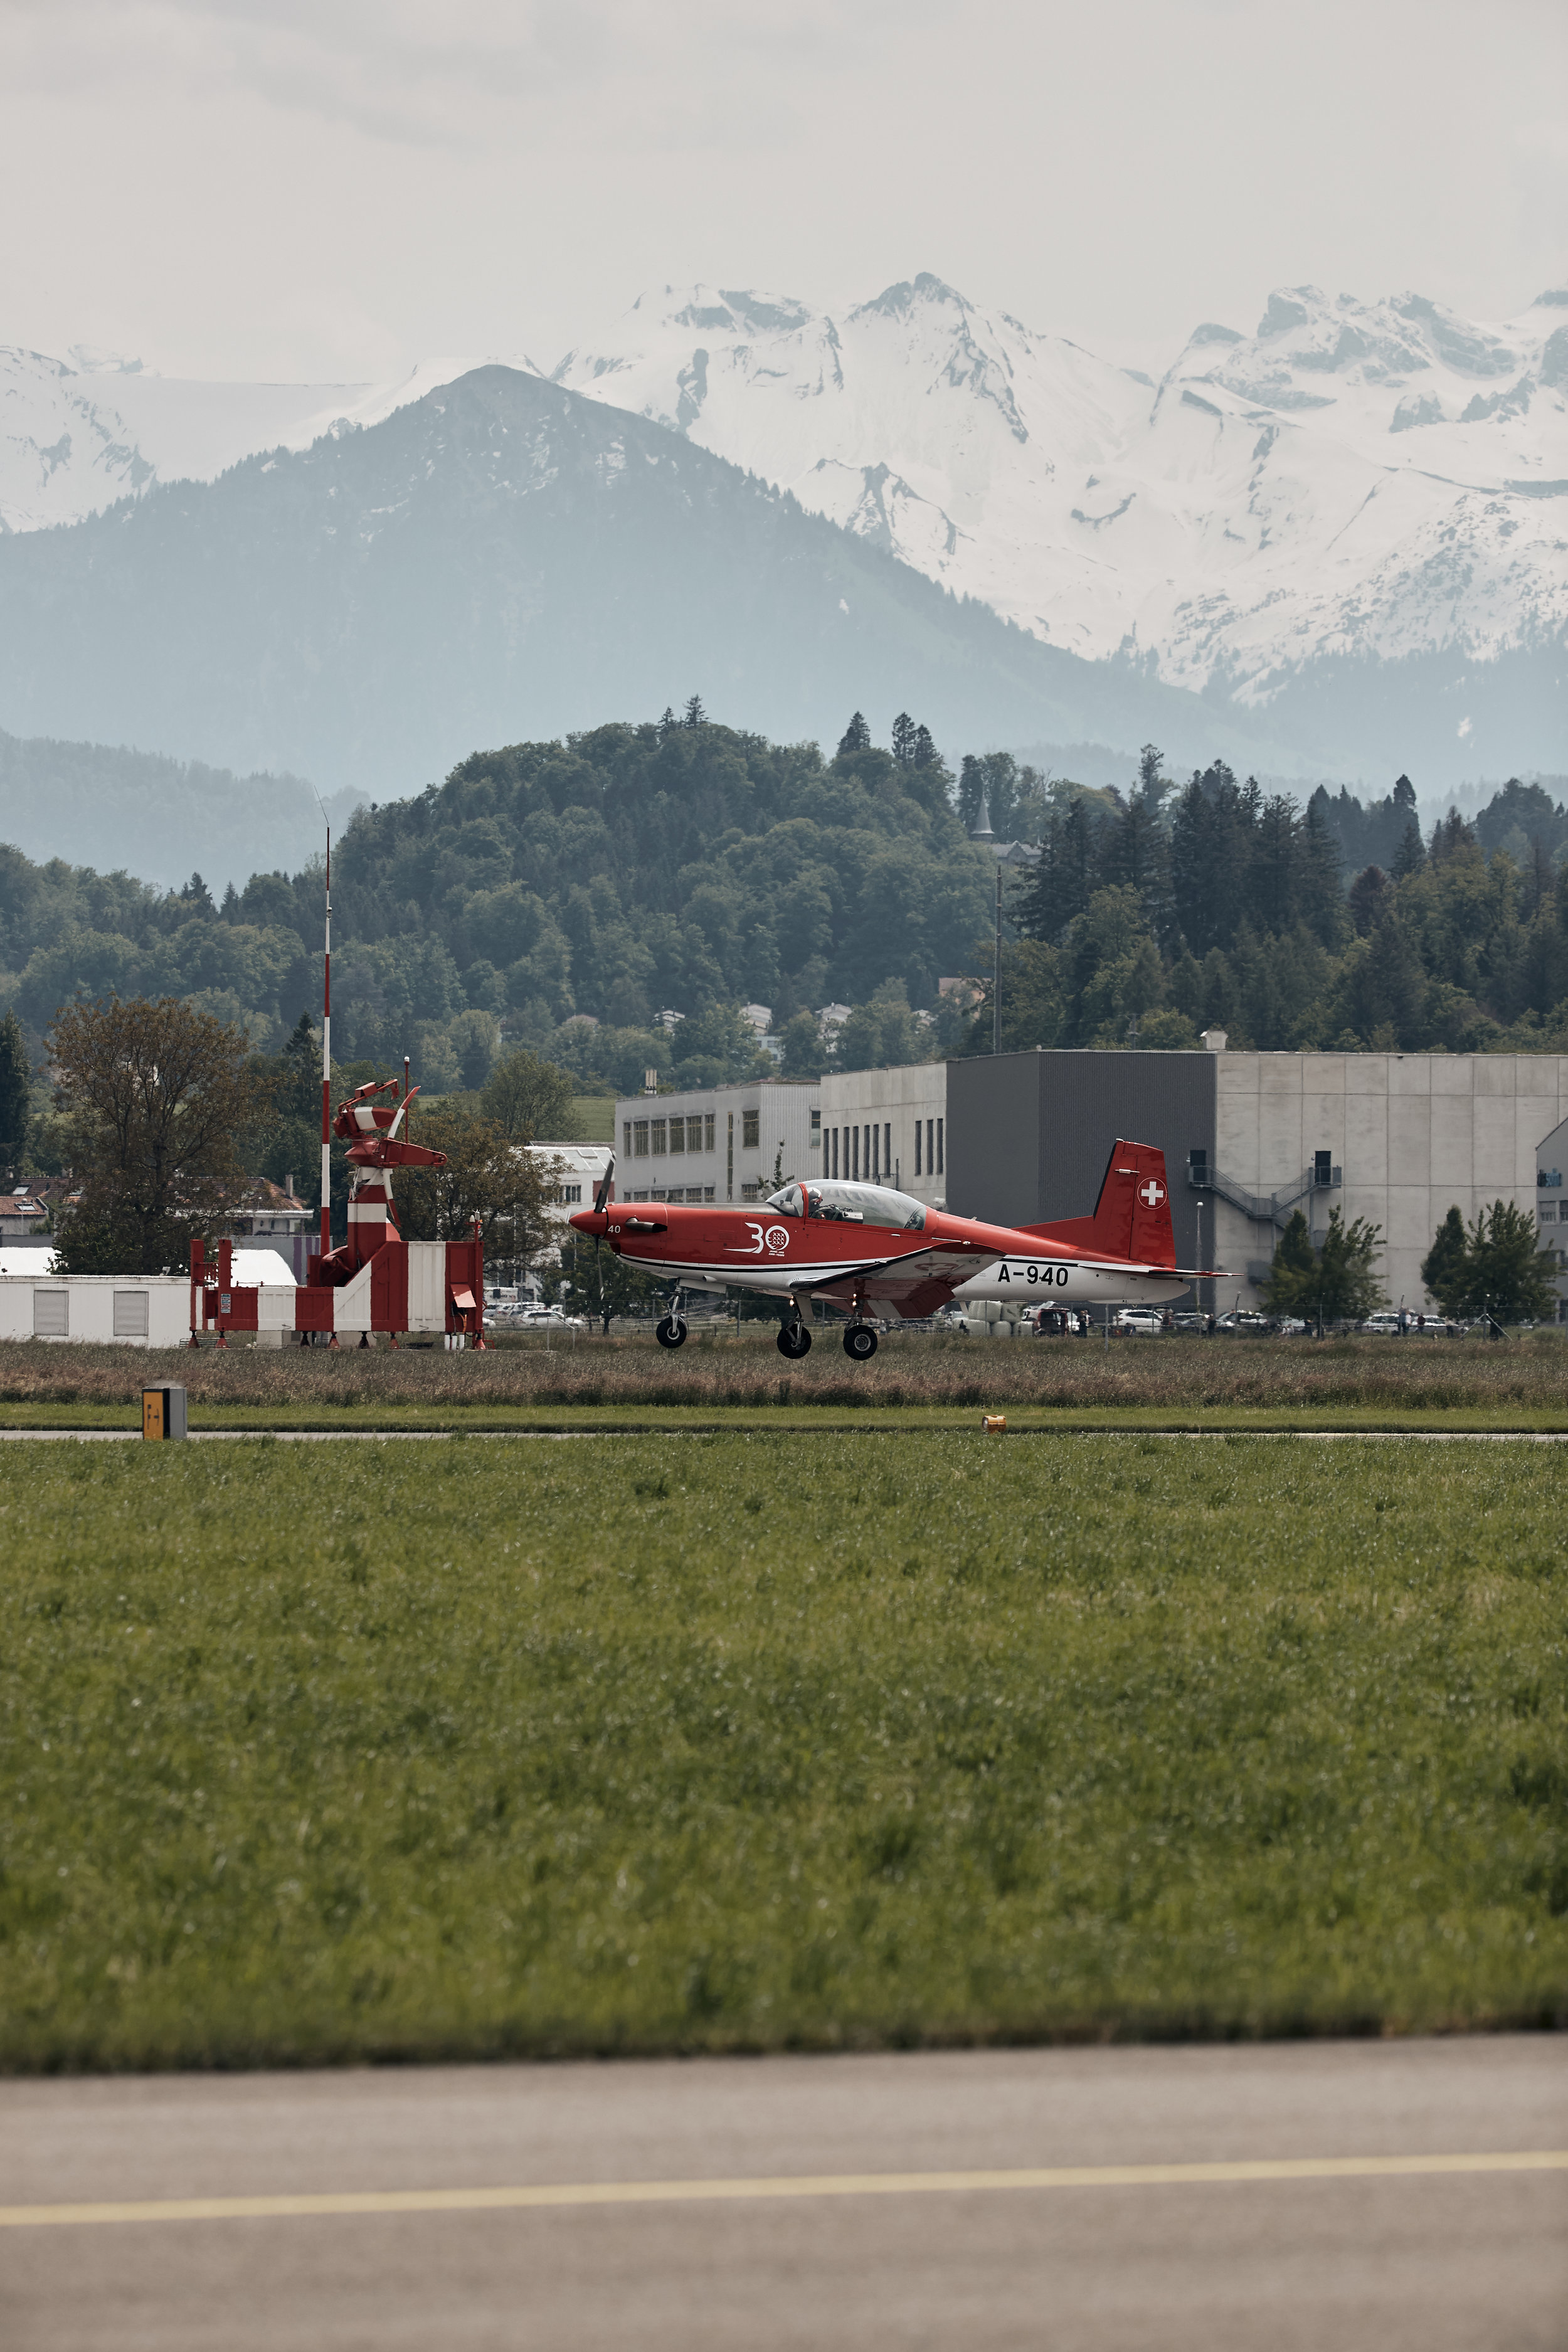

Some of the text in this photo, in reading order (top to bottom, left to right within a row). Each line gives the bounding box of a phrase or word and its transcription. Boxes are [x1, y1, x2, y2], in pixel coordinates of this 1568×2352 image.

[608, 1225, 621, 1233] 40
[723, 1222, 790, 1254] 30
[997, 1264, 1069, 1286] A-940
